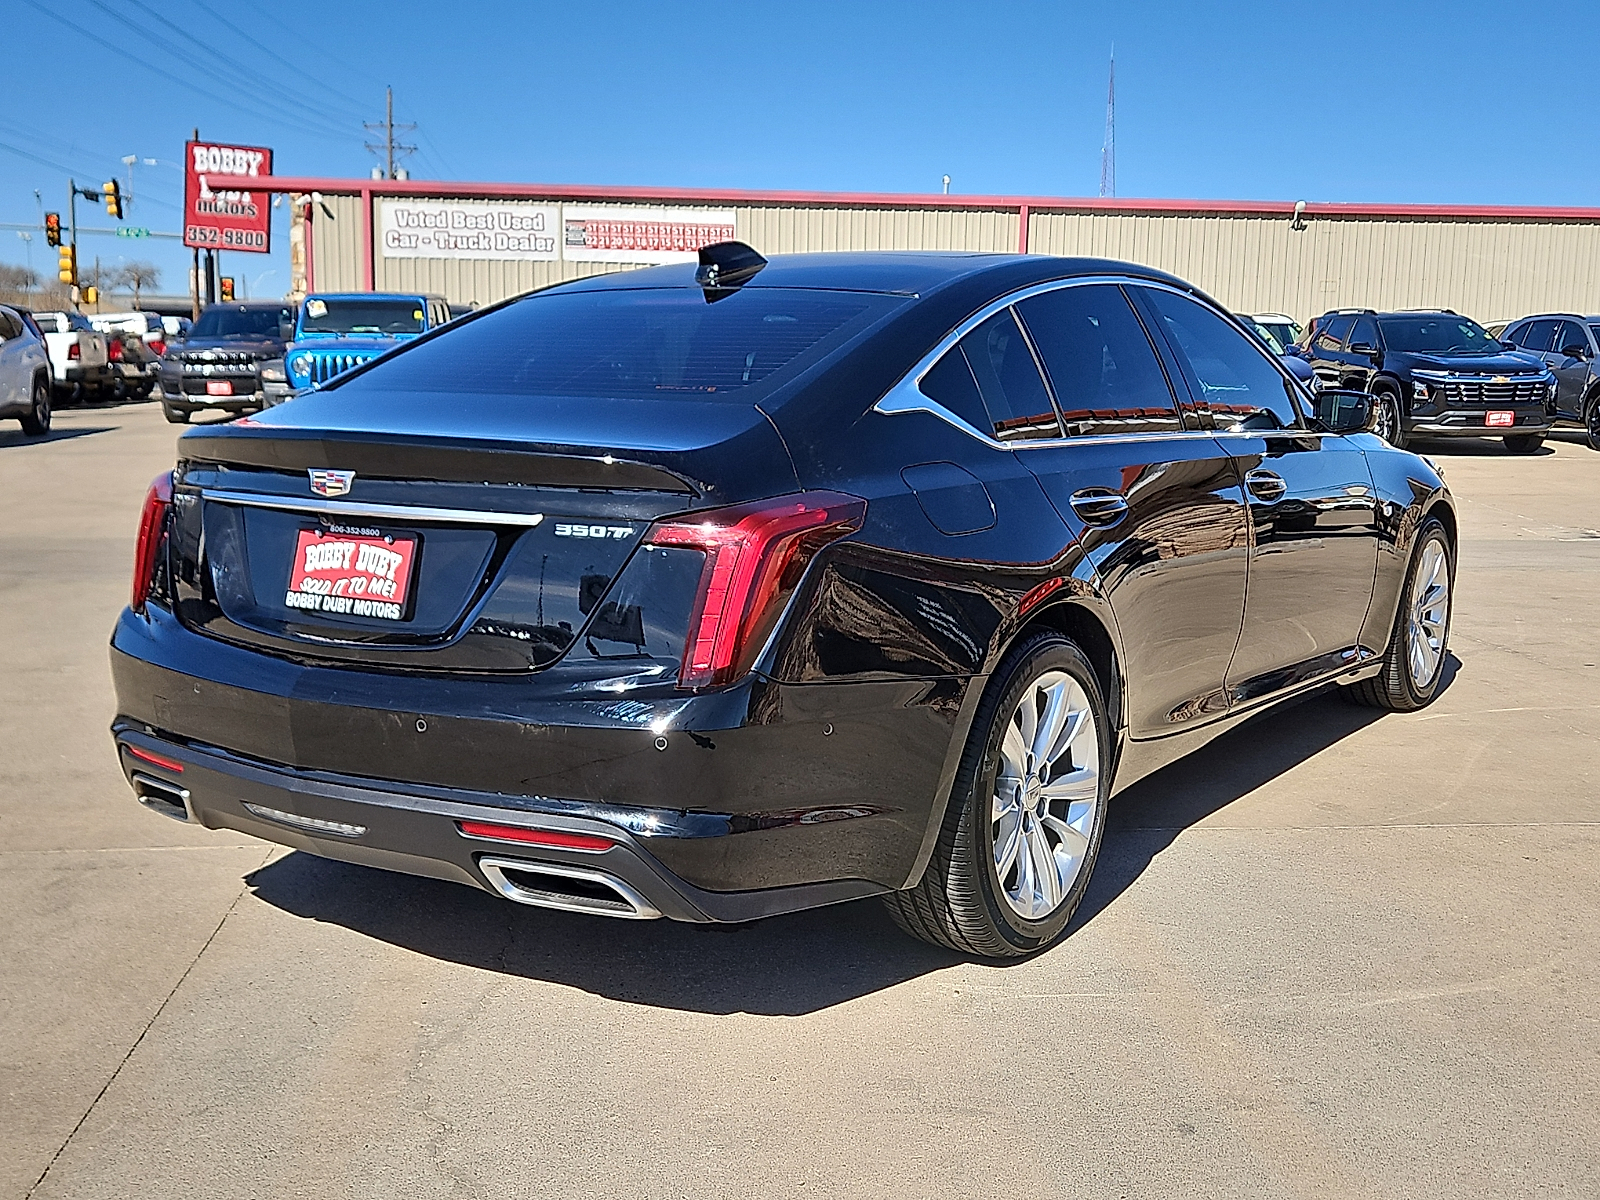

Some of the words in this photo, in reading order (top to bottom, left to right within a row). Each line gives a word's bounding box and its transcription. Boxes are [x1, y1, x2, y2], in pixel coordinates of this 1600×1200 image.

[193, 146, 263, 176] BOBBY
[395, 209, 448, 229] Voted
[451, 210, 494, 230] Best
[498, 211, 545, 231] Used
[188, 226, 264, 246] 352-9800
[385, 229, 418, 248] Car
[433, 230, 491, 250] Truck
[494, 232, 555, 252] Dealer
[304, 541, 356, 573] BOBBY
[355, 543, 403, 581] DUBY
[300, 576, 332, 595] SOLD
[331, 578, 351, 596] IT
[347, 576, 368, 595] TO
[367, 576, 397, 600] ME!
[285, 590, 323, 611] BOBBY
[321, 595, 355, 614] DUBY
[352, 597, 401, 620] MOTORS
